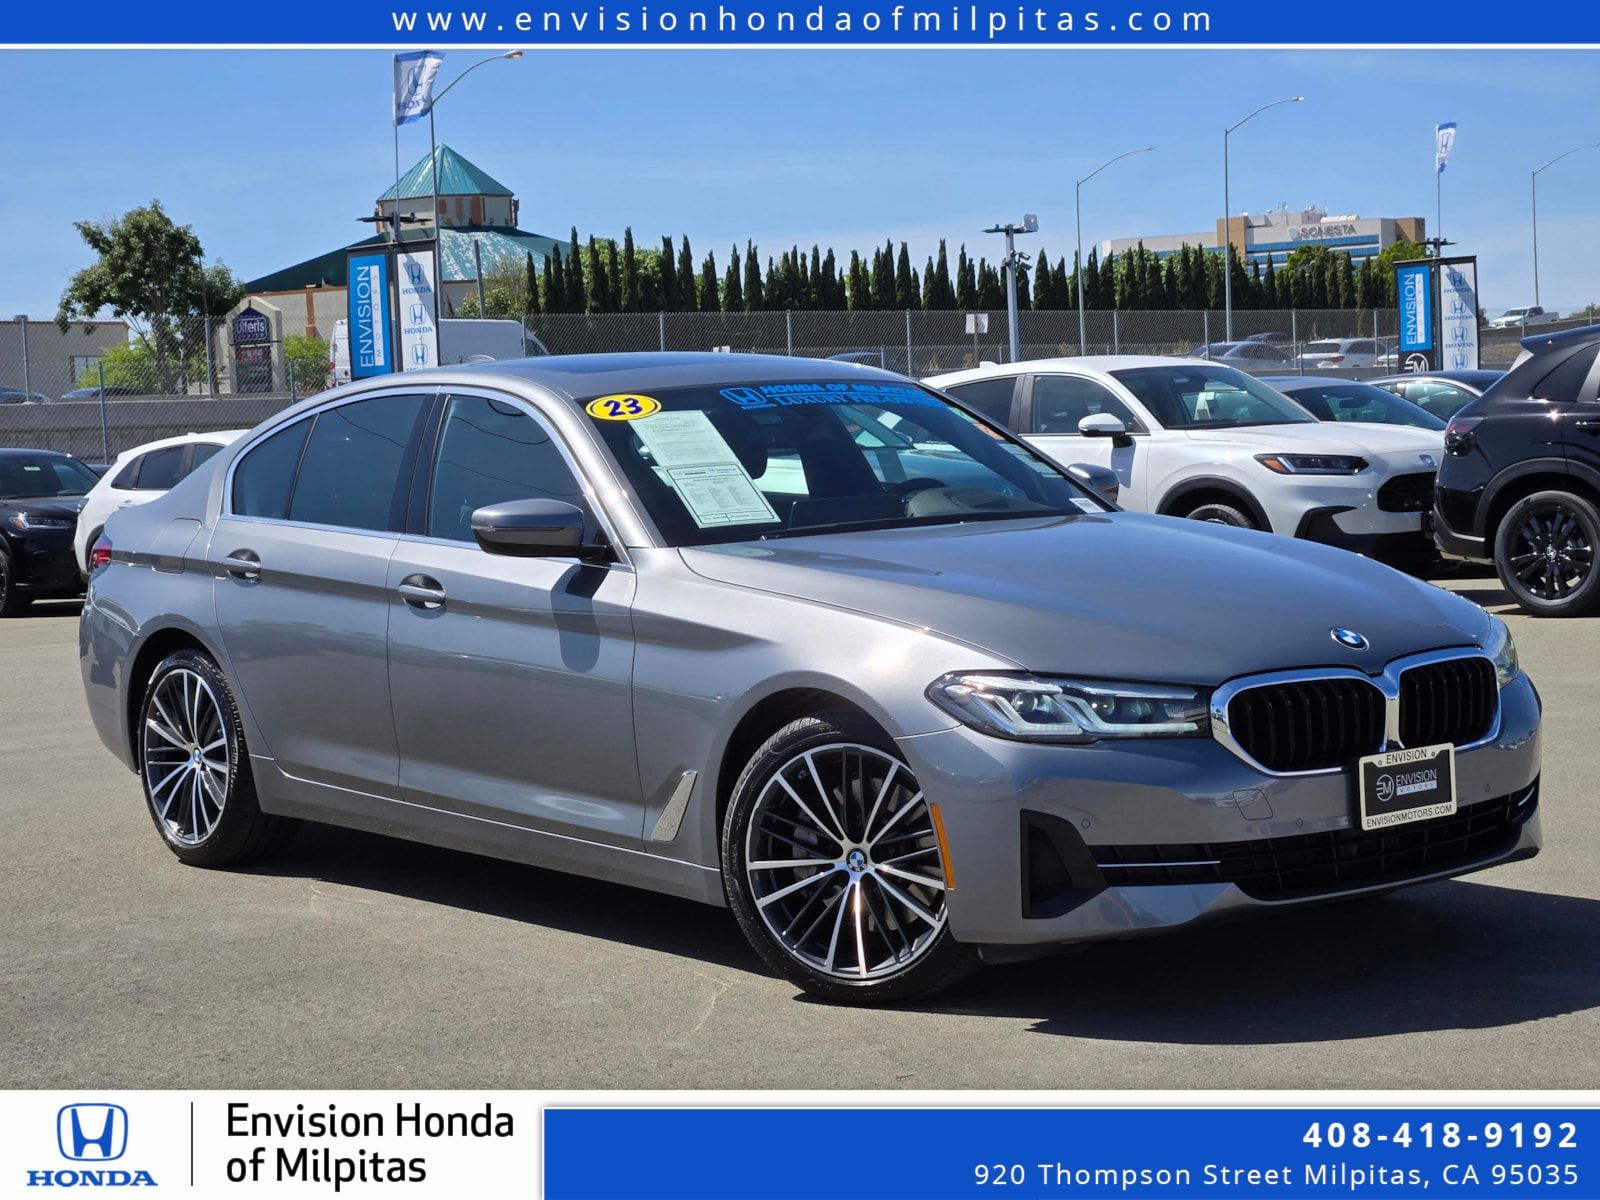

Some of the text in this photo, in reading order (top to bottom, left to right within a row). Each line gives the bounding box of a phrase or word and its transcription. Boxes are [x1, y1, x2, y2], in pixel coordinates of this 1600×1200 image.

[1300, 224, 1357, 239] SONESTA
[402, 286, 432, 294] HONDA
[356, 265, 374, 367] ENVISION
[372, 275, 382, 358] MOTORS
[1404, 274, 1417, 345] ENVISION
[403, 327, 433, 335] HONDA
[759, 383, 824, 395] HONDA
[828, 383, 850, 392] OF
[604, 396, 645, 418] 23
[773, 394, 850, 406] LUXURY
[1386, 749, 1427, 764] ENVISION
[1395, 769, 1437, 786] ENVISION
[1399, 782, 1435, 793] MOTORS
[1366, 804, 1453, 828] ENVISIONMOTORS.COM
